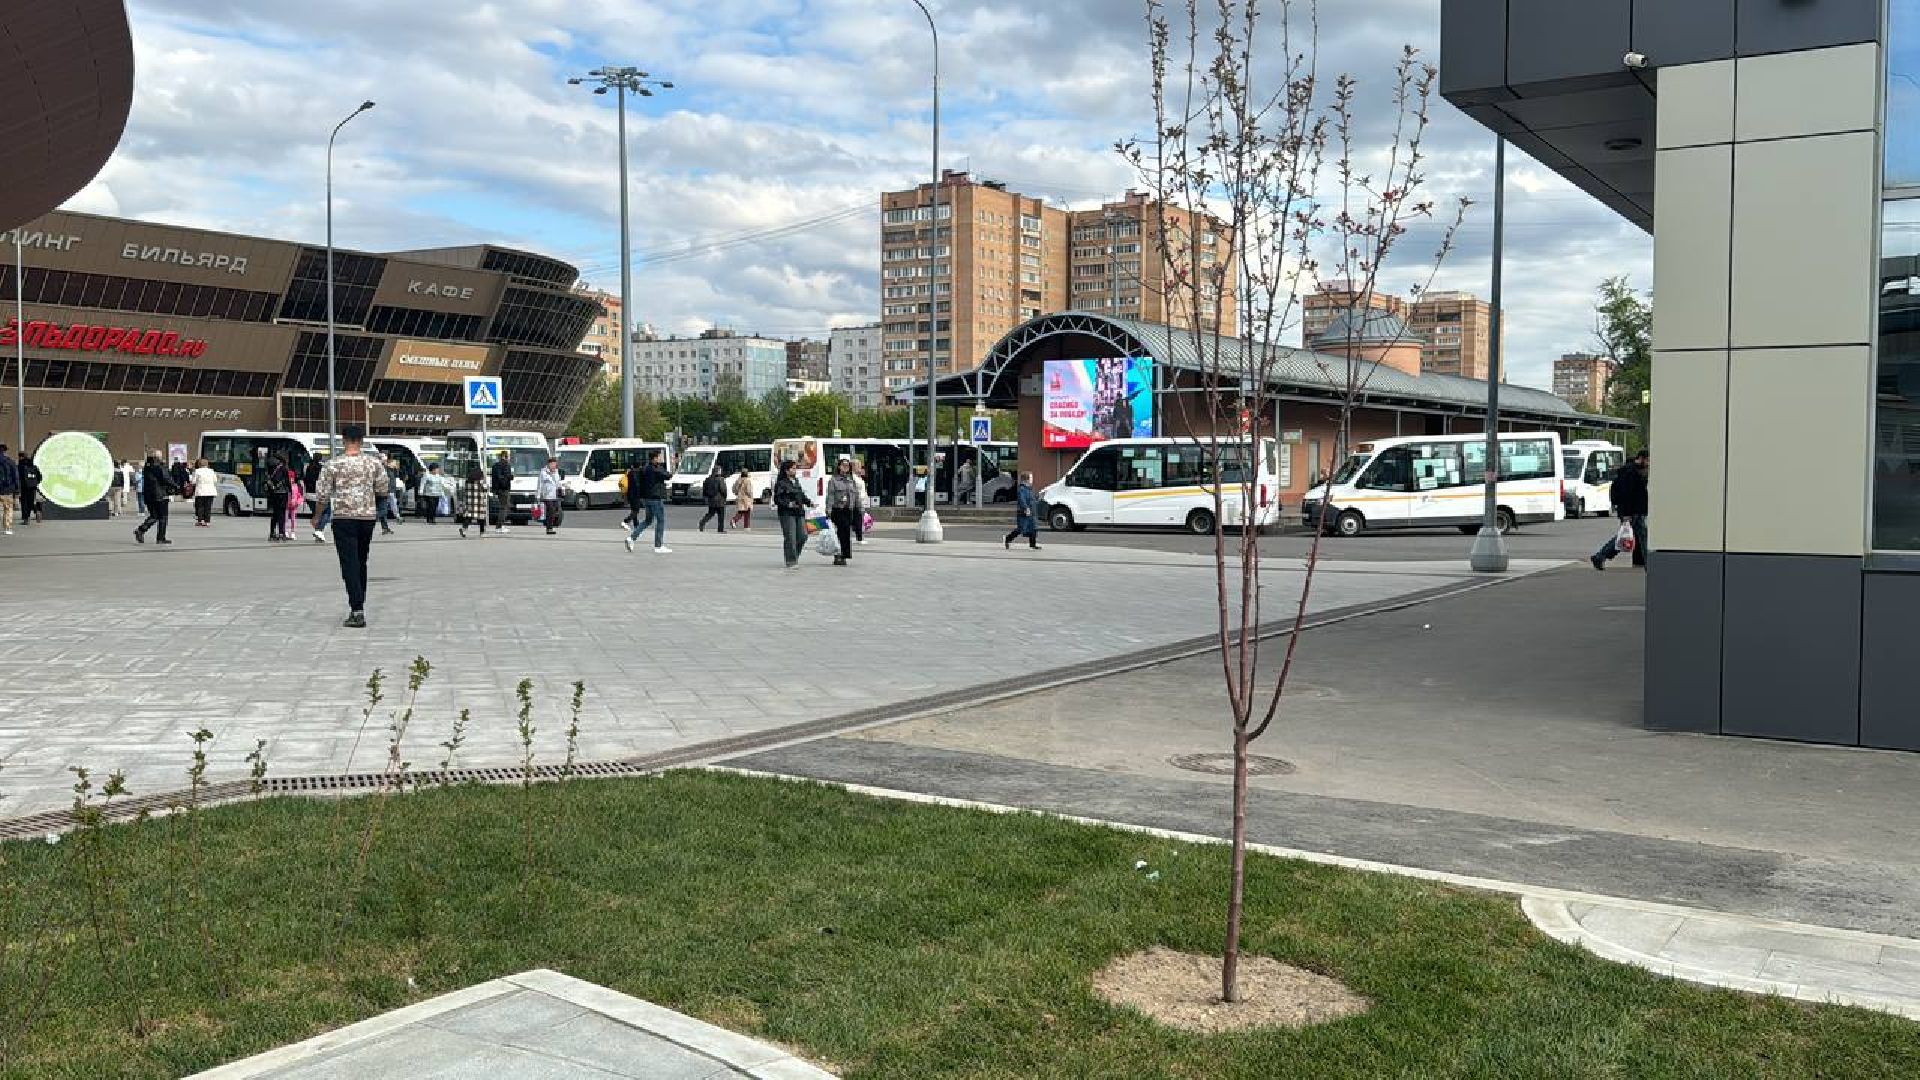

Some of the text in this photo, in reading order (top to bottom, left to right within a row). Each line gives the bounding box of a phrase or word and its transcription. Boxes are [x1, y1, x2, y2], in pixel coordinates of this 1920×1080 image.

[122, 243, 247, 274] БИЛЬЯРД
[408, 280, 474, 299] КАФЕ
[390, 413, 451, 424] SUNLIGHT
